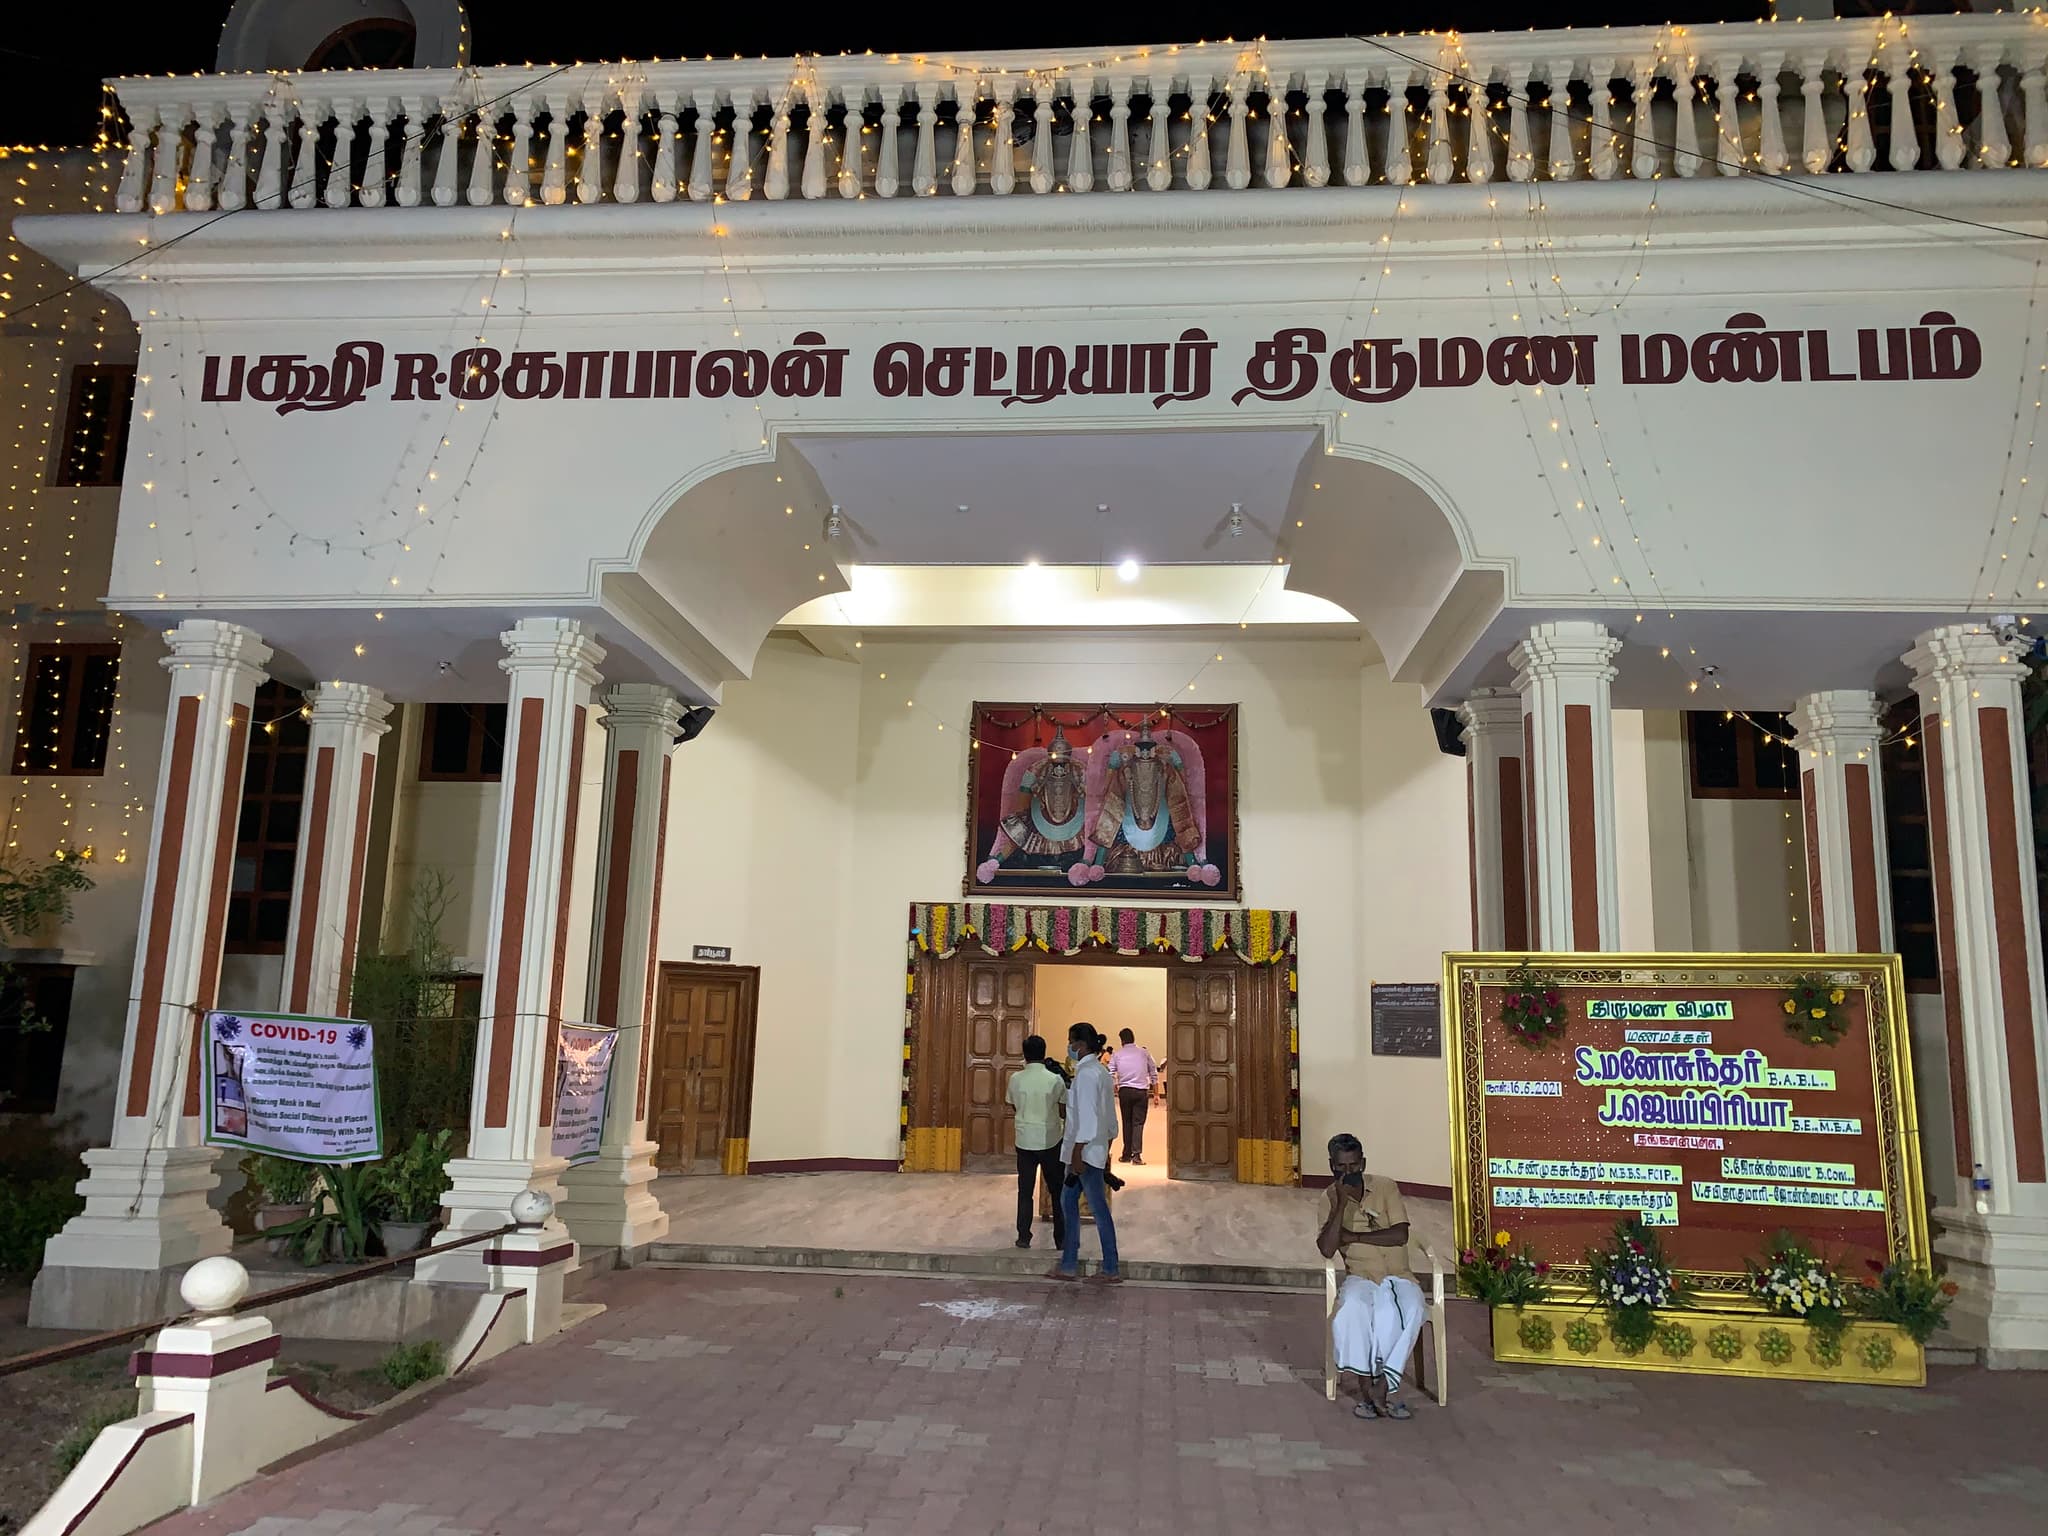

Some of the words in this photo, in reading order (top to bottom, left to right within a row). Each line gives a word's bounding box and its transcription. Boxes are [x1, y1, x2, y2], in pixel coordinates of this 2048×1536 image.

[873, 327, 1218, 410] செட்டியார்
[1231, 327, 1598, 408] திருமண
[1620, 310, 1982, 385] மண்டபம்
[1590, 1000, 1667, 1019] திருமண
[1675, 1001, 1727, 1019] விழா
[251, 1022, 337, 1045] COVID-19
[1627, 1030, 1710, 1043] மணமக்கள்
[279, 1111, 300, 1120] Social
[344, 1115, 368, 1123] Places
[338, 1127, 354, 1136] With
[356, 1126, 373, 1135] Soap
